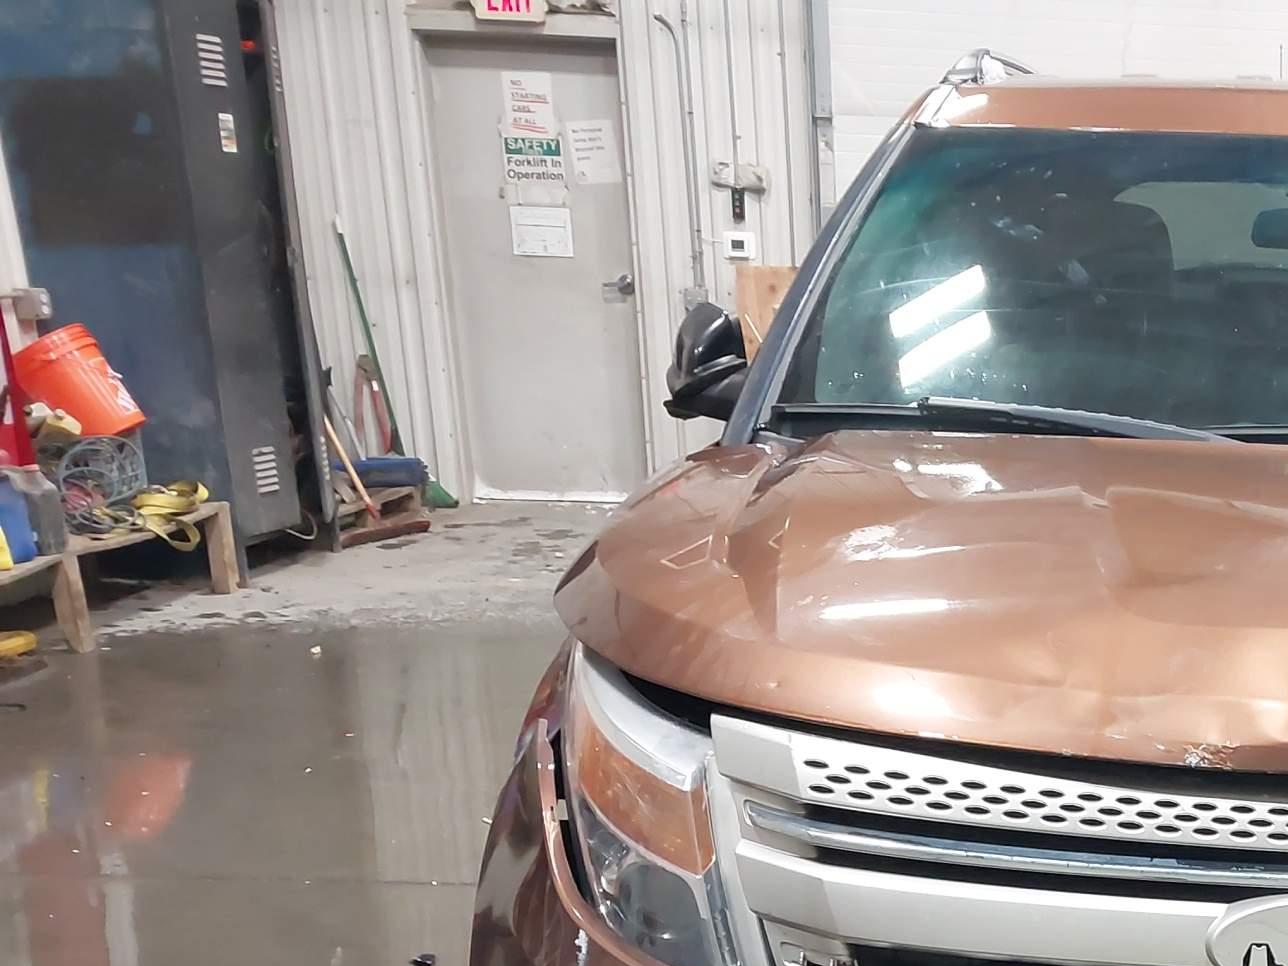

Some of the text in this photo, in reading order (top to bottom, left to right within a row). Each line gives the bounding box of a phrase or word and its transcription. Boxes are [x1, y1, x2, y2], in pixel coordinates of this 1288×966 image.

[506, 138, 557, 151] SAFETY
[507, 156, 562, 168] Forklift In
[507, 169, 564, 181] Operation
